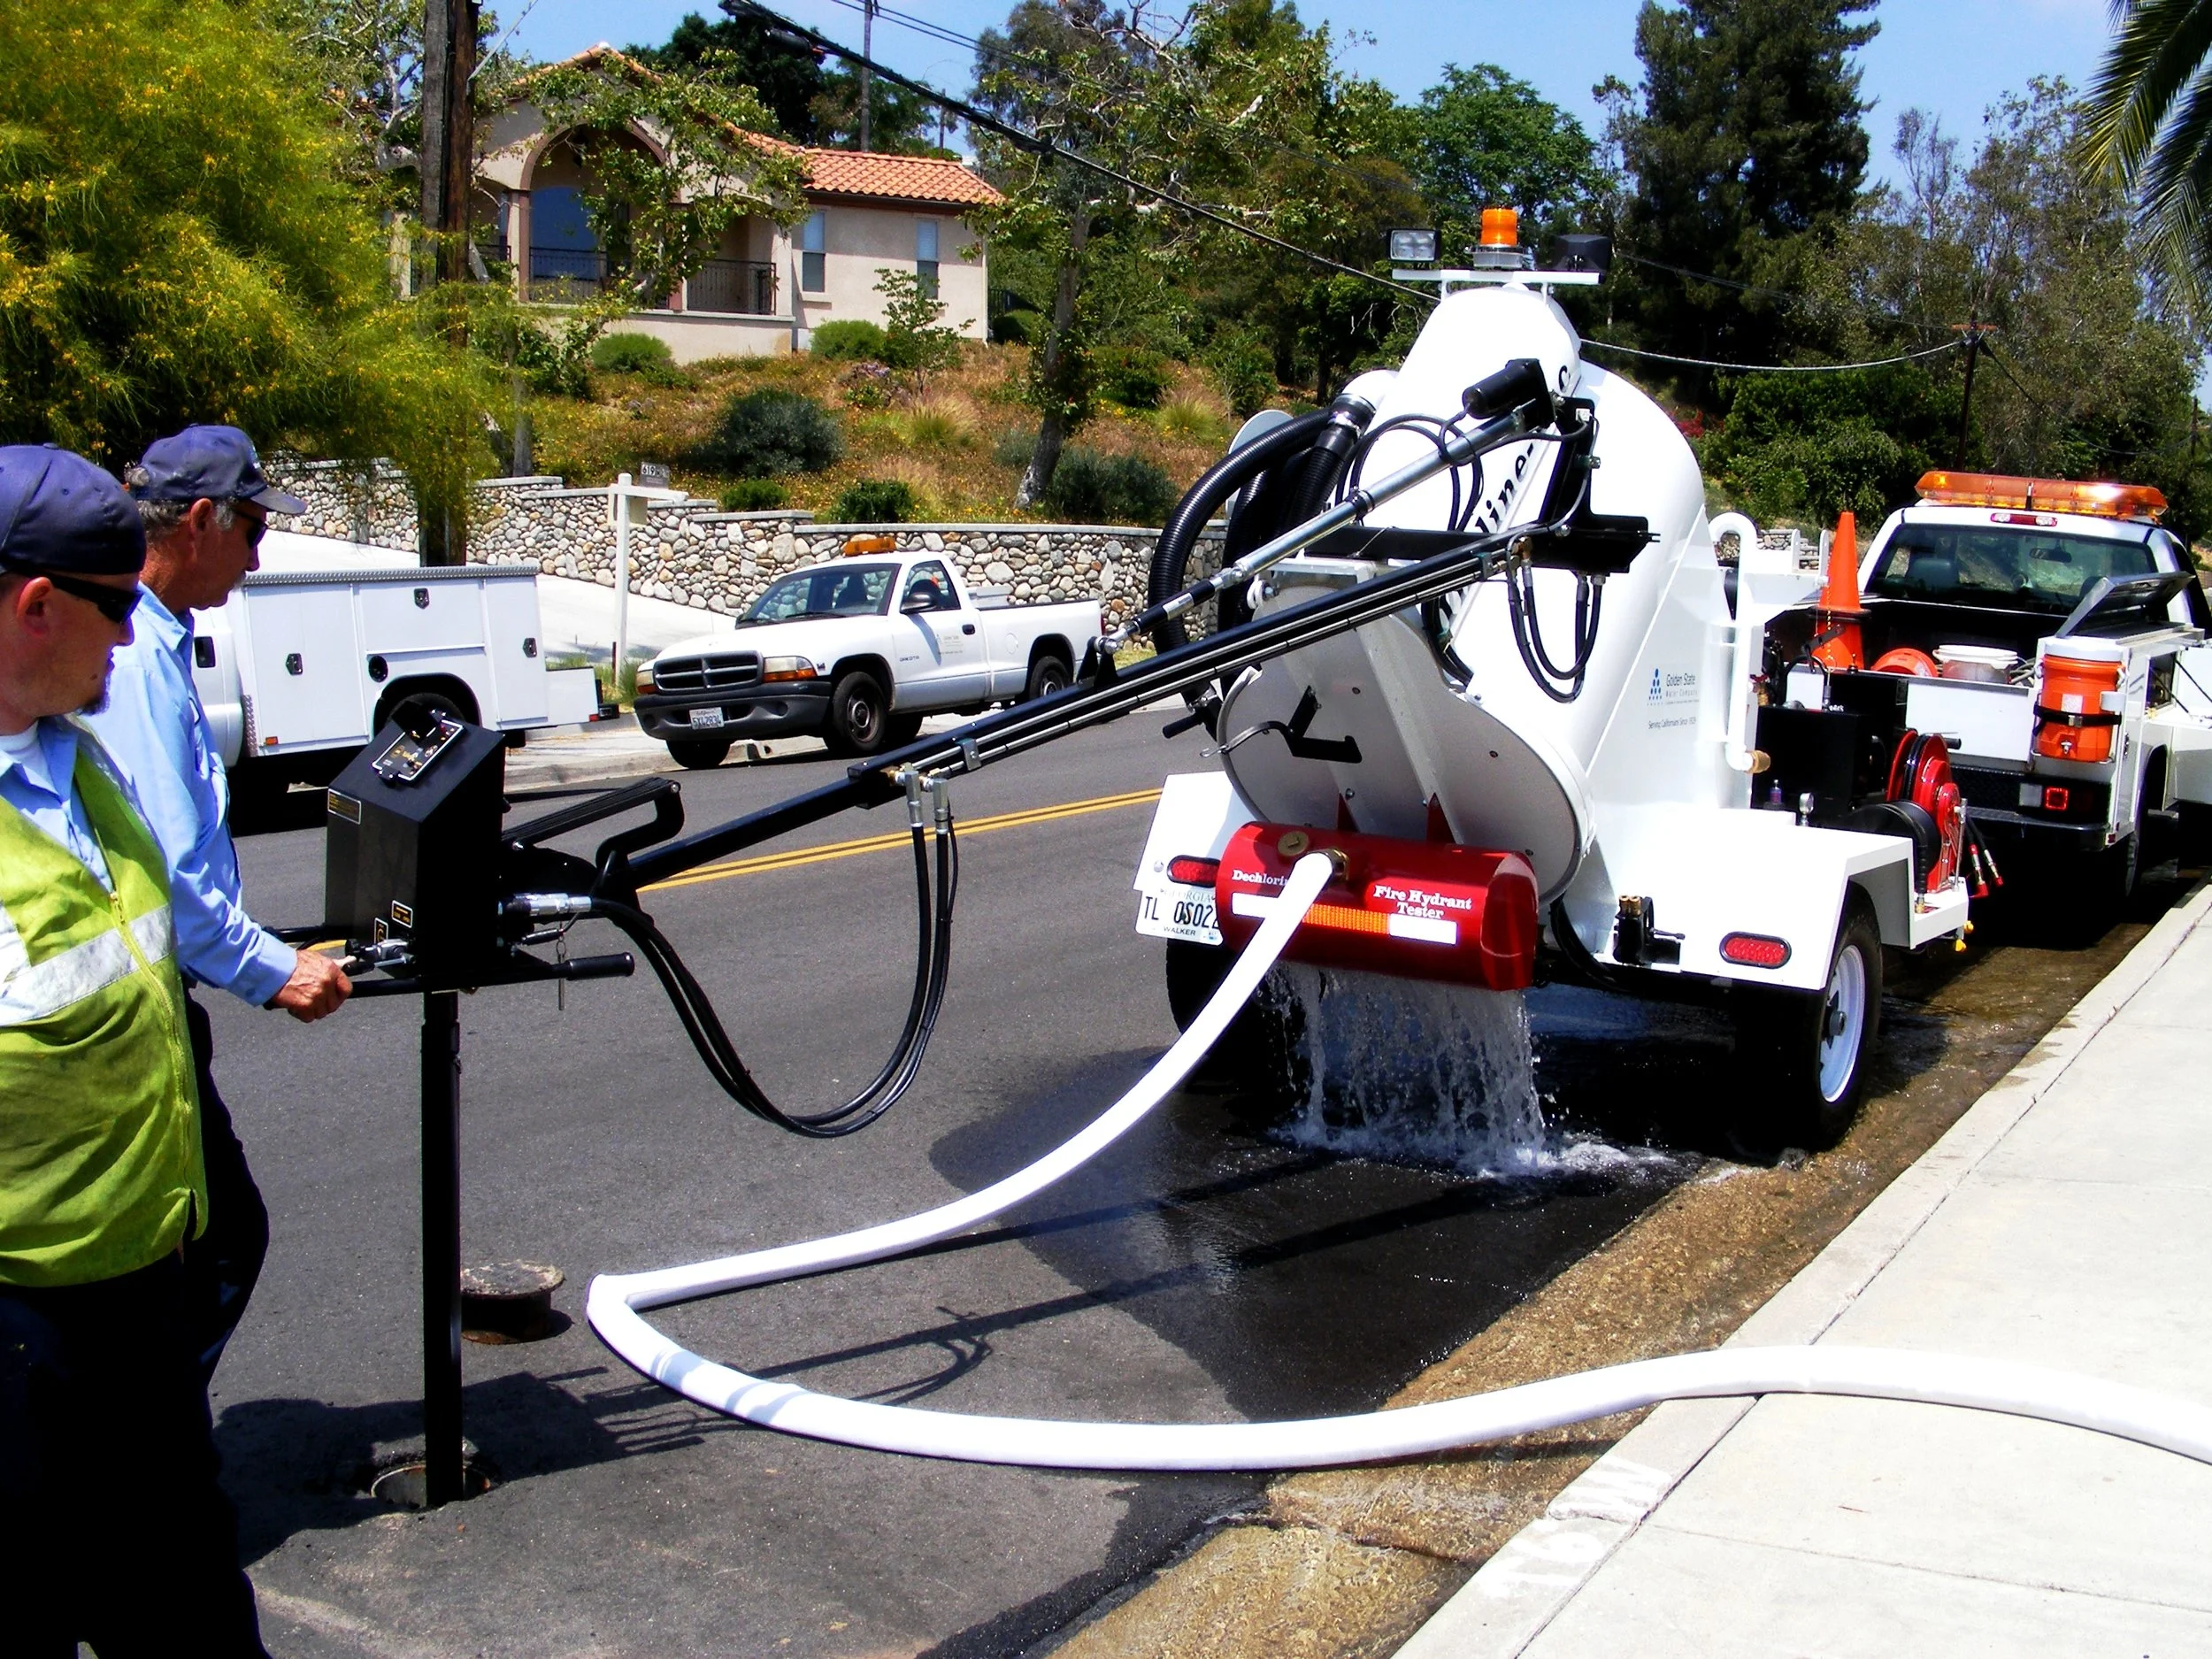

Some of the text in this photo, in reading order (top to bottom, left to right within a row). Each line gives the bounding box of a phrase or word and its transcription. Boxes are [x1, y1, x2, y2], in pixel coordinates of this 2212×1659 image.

[1144, 895, 1159, 920] TL
[1373, 885, 1472, 910] Fire Hydrant
[1397, 901, 1444, 919] Tester
[1164, 926, 1195, 935] WALKER
